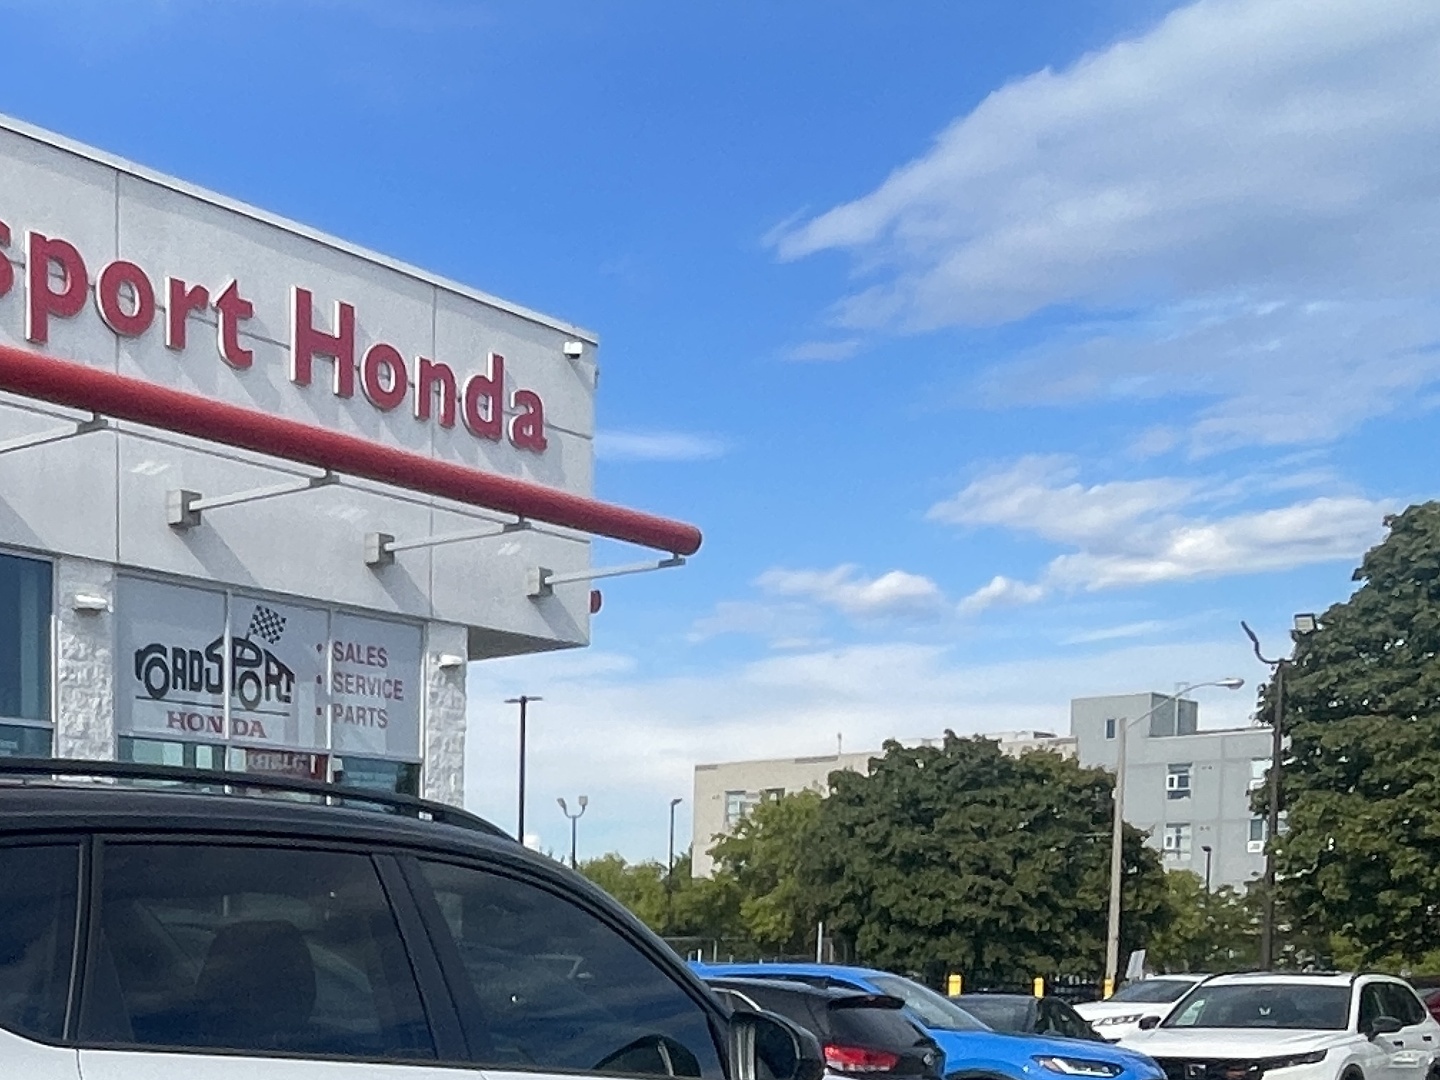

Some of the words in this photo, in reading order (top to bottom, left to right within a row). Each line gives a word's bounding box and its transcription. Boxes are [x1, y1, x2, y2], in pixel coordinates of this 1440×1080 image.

[290, 285, 547, 454] Honda
[332, 641, 388, 669] SALES
[332, 671, 405, 701] SERVICE
[166, 709, 268, 739] HONDA
[332, 703, 389, 731] PARTS
